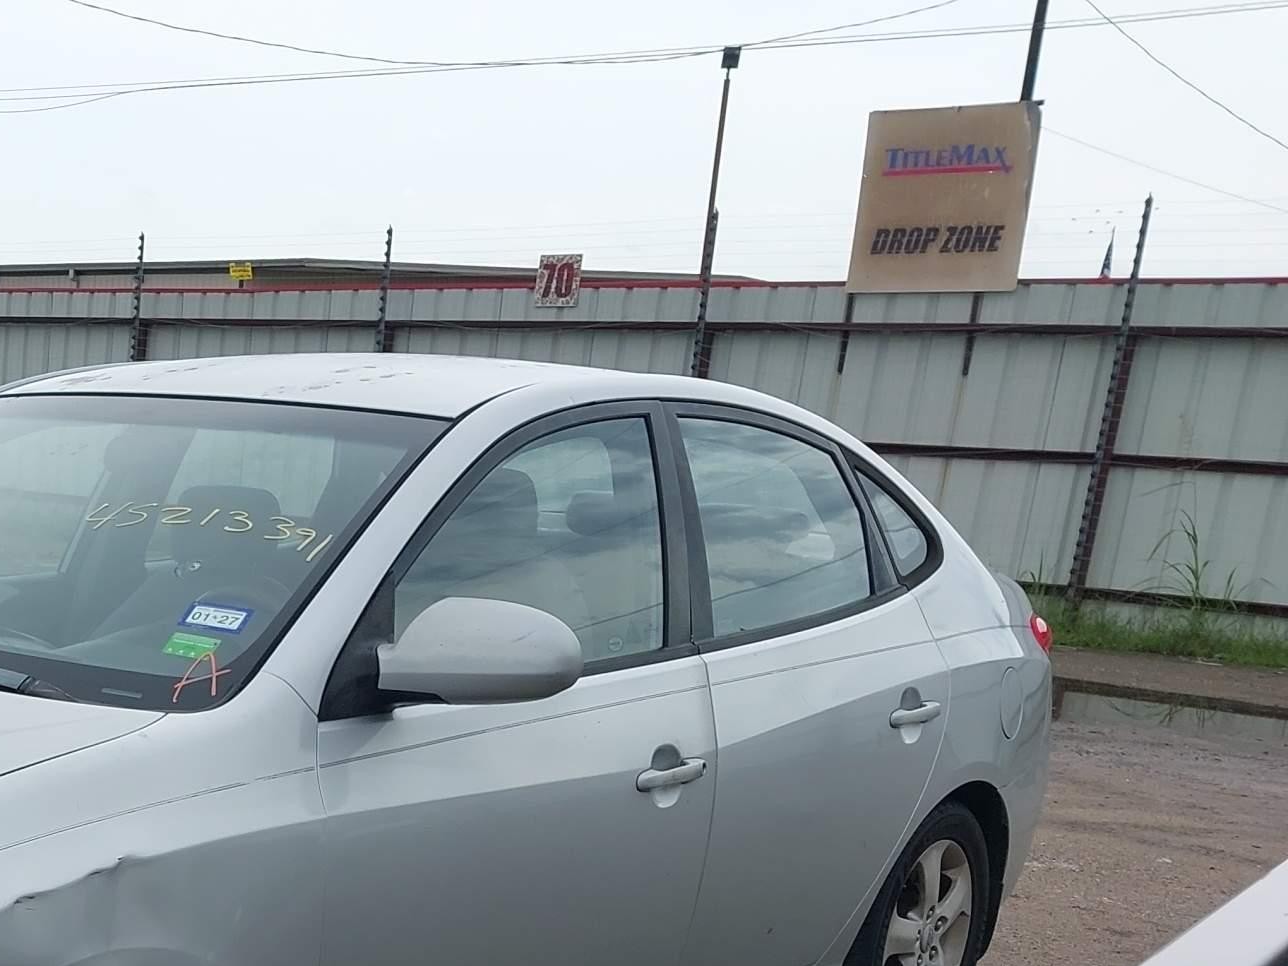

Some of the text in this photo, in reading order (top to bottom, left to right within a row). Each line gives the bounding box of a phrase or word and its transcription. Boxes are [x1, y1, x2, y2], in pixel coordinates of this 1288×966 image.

[870, 225, 1005, 255] DROP ZONE
[542, 262, 575, 298] 70
[172, 651, 233, 703] A
